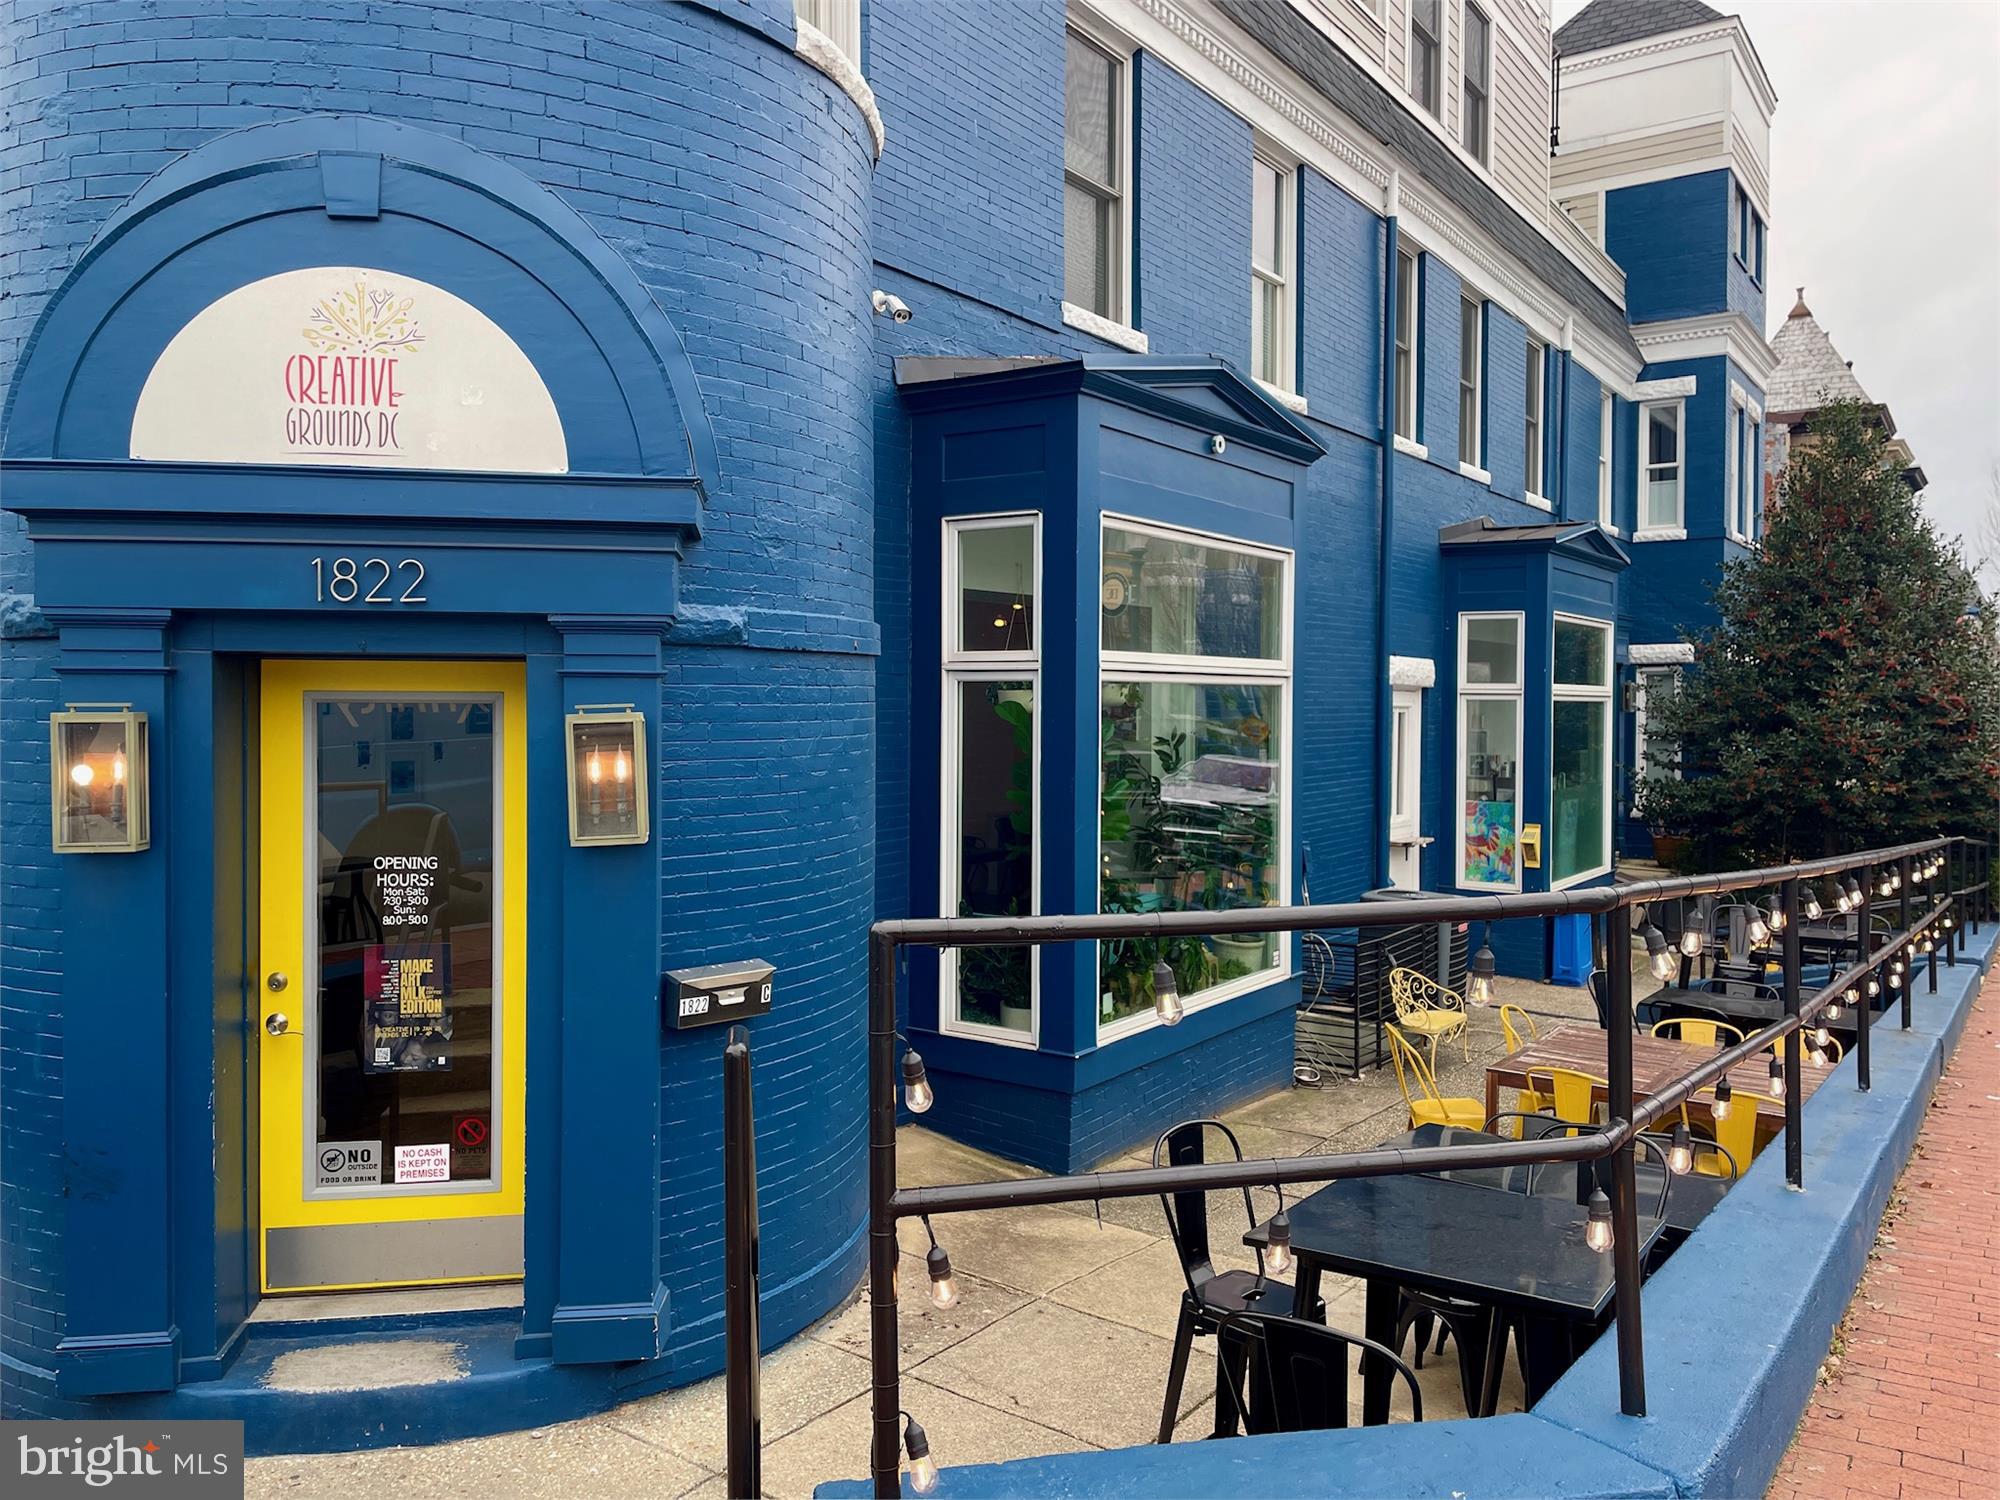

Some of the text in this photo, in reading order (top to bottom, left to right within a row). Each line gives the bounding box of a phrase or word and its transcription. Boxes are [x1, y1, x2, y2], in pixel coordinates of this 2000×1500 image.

[285, 354, 404, 407] CREATIVE
[286, 407, 399, 449] GROUNDS DC
[311, 557, 427, 602] 1822
[373, 856, 439, 871] OPENING
[376, 873, 434, 887] HOURS:
[393, 905, 416, 914] Sun:
[400, 959, 433, 973] MAKE
[400, 973, 422, 986] ART
[400, 986, 426, 1000] MLK
[682, 985, 770, 1015] 1822 C
[400, 999, 442, 1014] EDITION
[348, 1149, 371, 1163] NO
[402, 1148, 443, 1158] NO CASH
[397, 1160, 406, 1168] IS
[408, 1158, 432, 1168] KEPT
[433, 1157, 447, 1167] ON
[400, 1168, 446, 1179] PREMISES
